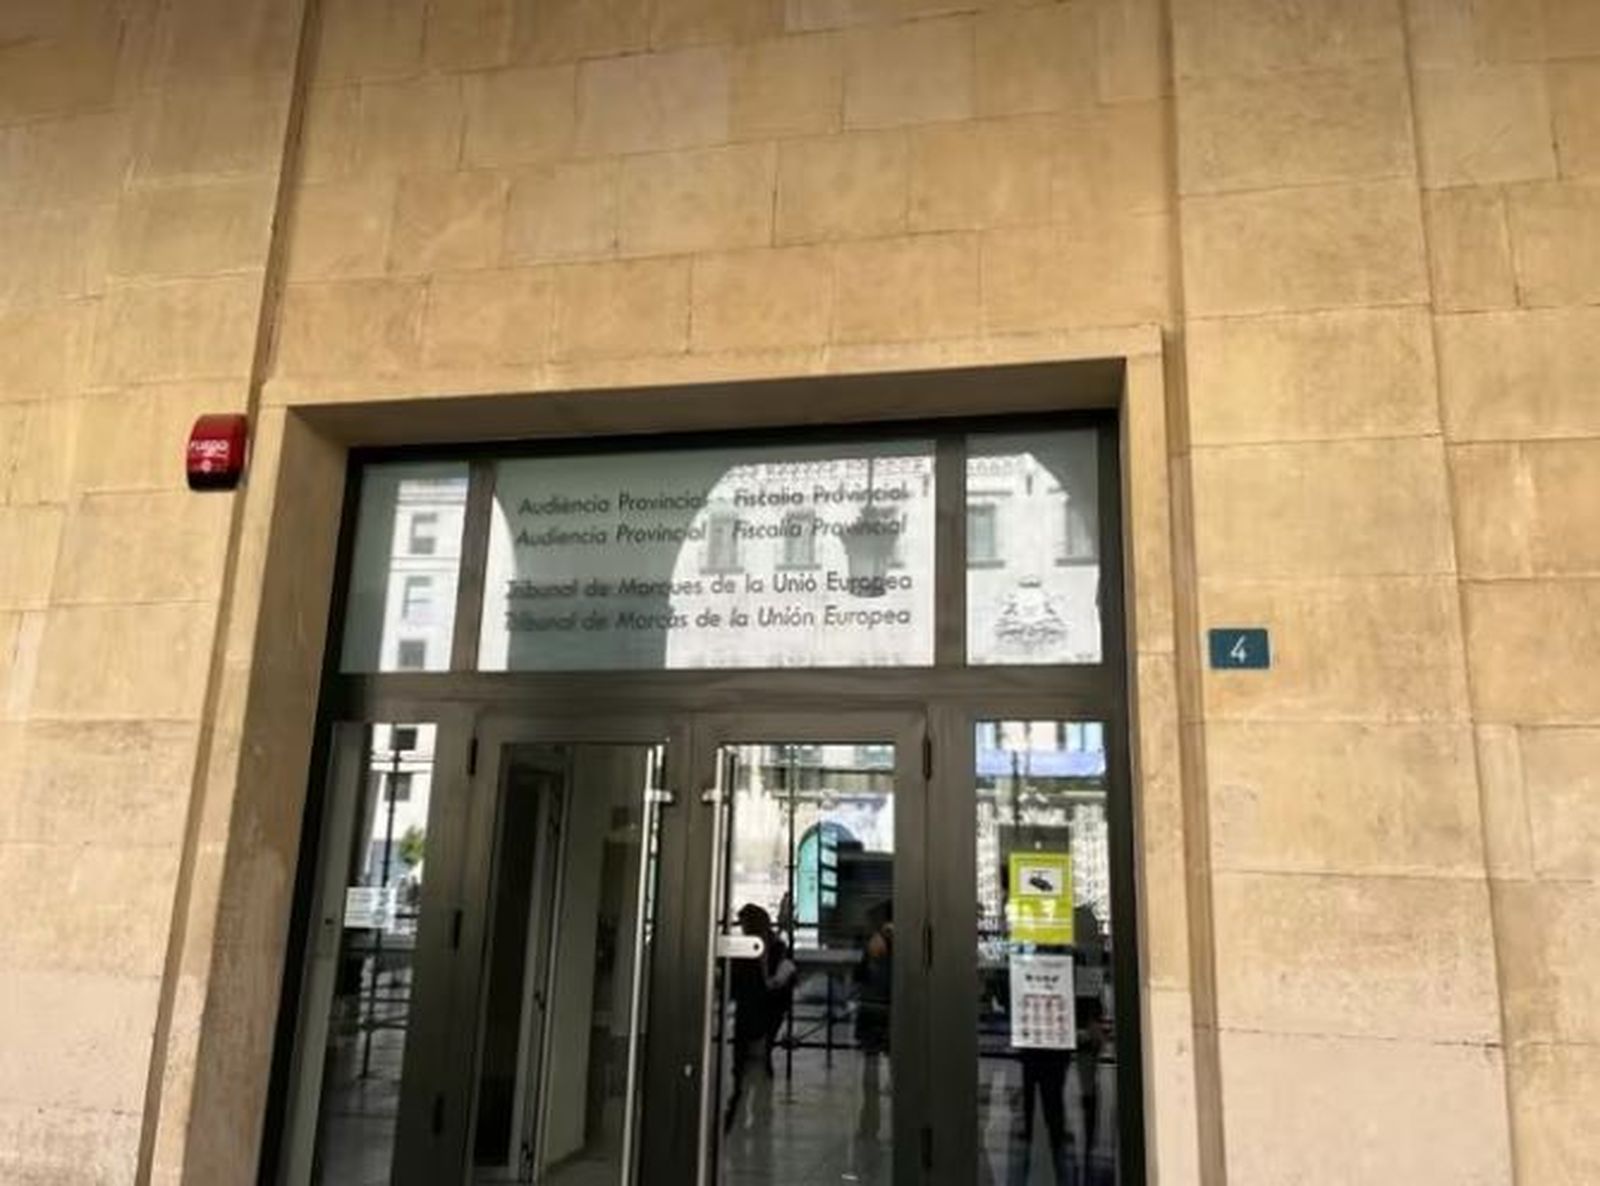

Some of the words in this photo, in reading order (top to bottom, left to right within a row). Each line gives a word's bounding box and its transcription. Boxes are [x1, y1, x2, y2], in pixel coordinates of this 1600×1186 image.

[619, 487, 709, 511] Provincial
[813, 481, 909, 505] Provincial
[517, 525, 607, 546] Audiencia
[616, 521, 706, 544] Provincial
[732, 518, 803, 541] Fiscalía
[812, 513, 908, 538] Provincial
[585, 578, 609, 597] de
[618, 577, 703, 599] Marques
[710, 574, 736, 595] de
[745, 574, 763, 594] la
[773, 572, 817, 594] Unió
[826, 572, 913, 597] Europea
[582, 610, 608, 630] de
[616, 608, 688, 630] Marcas
[695, 607, 720, 628] de
[729, 607, 748, 628] la
[758, 605, 815, 628] Unión
[824, 604, 911, 630] Europea
[1230, 635, 1247, 664] 4
